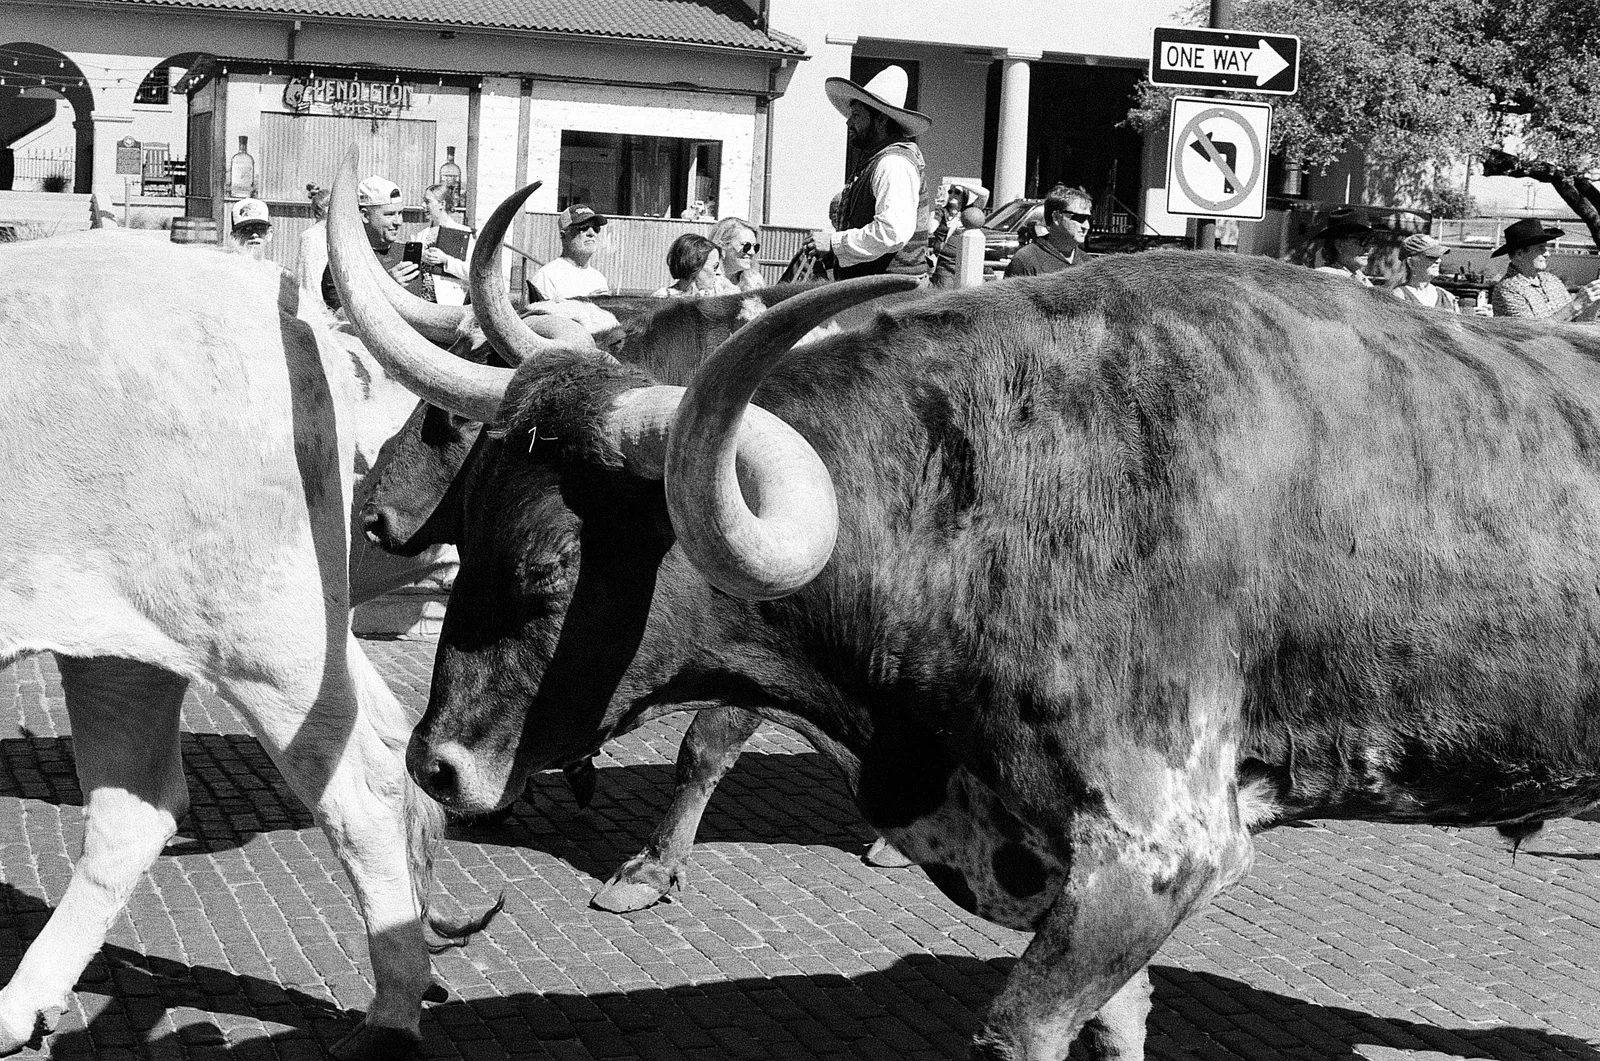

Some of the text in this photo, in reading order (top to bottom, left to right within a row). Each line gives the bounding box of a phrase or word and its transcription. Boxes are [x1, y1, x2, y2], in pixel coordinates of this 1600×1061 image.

[1167, 45, 1253, 72] ONE WAY
[313, 79, 414, 109] PENDLETON
